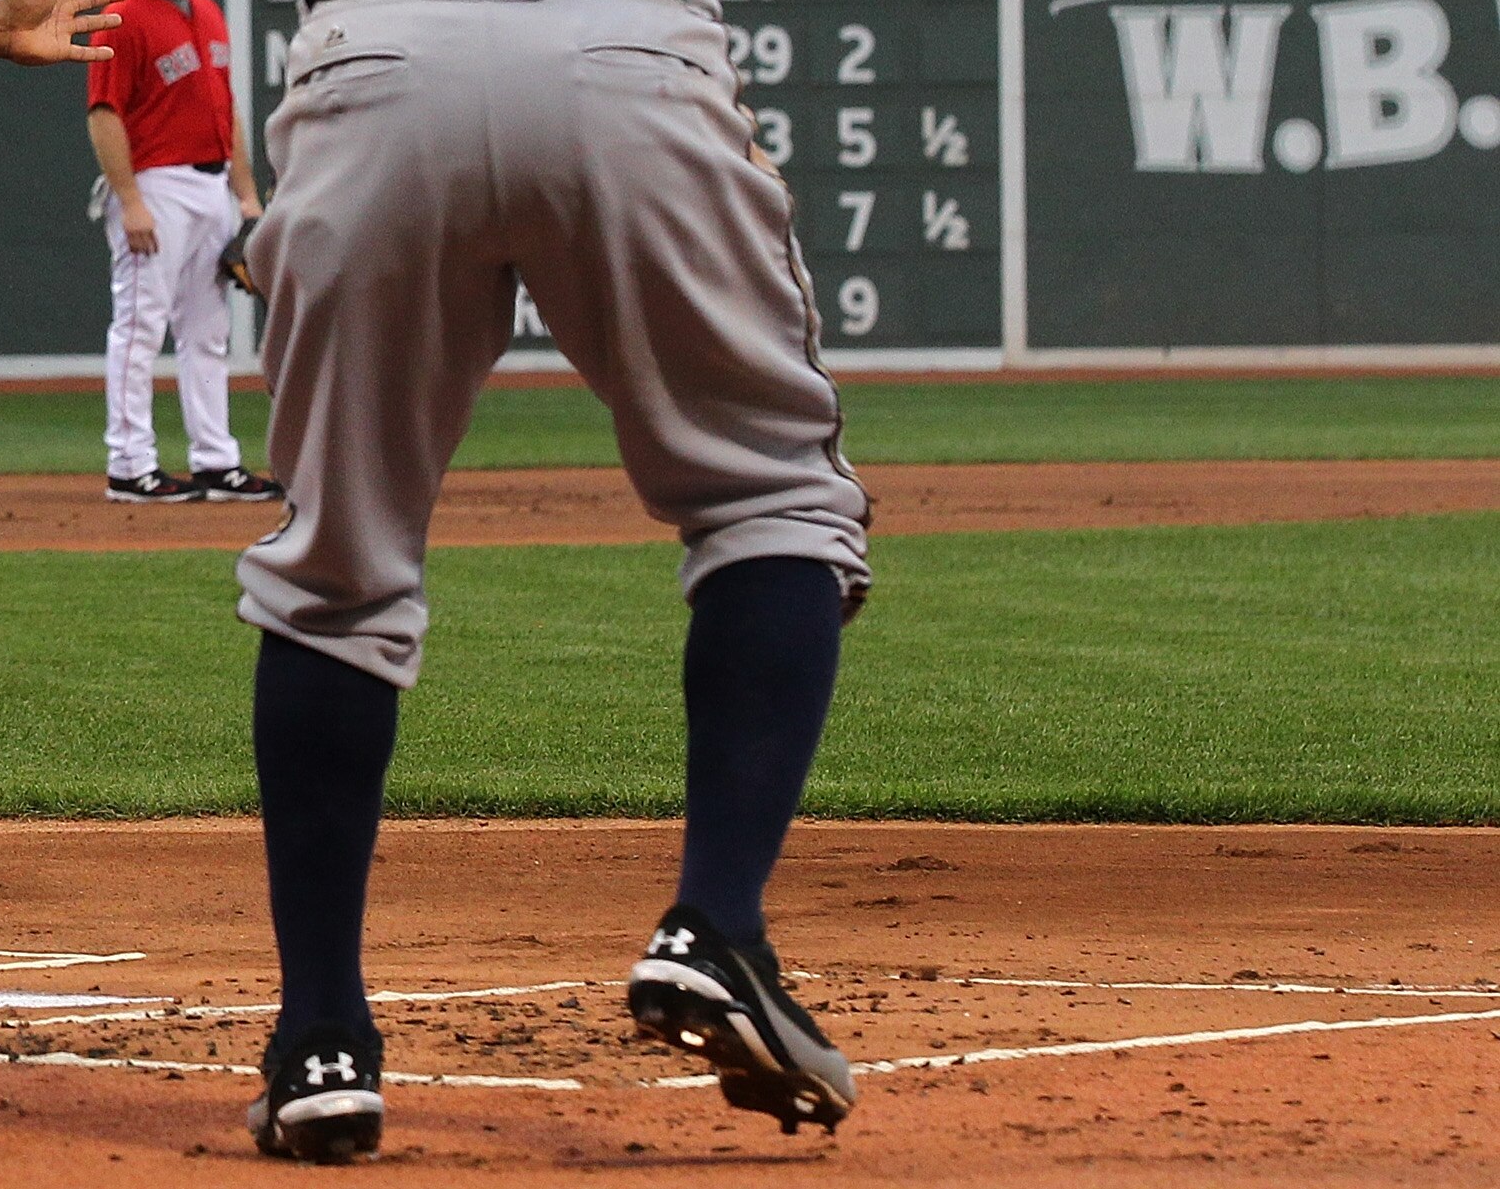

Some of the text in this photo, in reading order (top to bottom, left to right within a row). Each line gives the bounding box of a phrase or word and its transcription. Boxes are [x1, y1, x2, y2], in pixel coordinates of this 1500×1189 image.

[838, 23, 876, 84] 2
[755, 107, 793, 166] 3
[837, 106, 877, 167] 5
[838, 190, 876, 252] 7
[838, 275, 880, 336] 9
